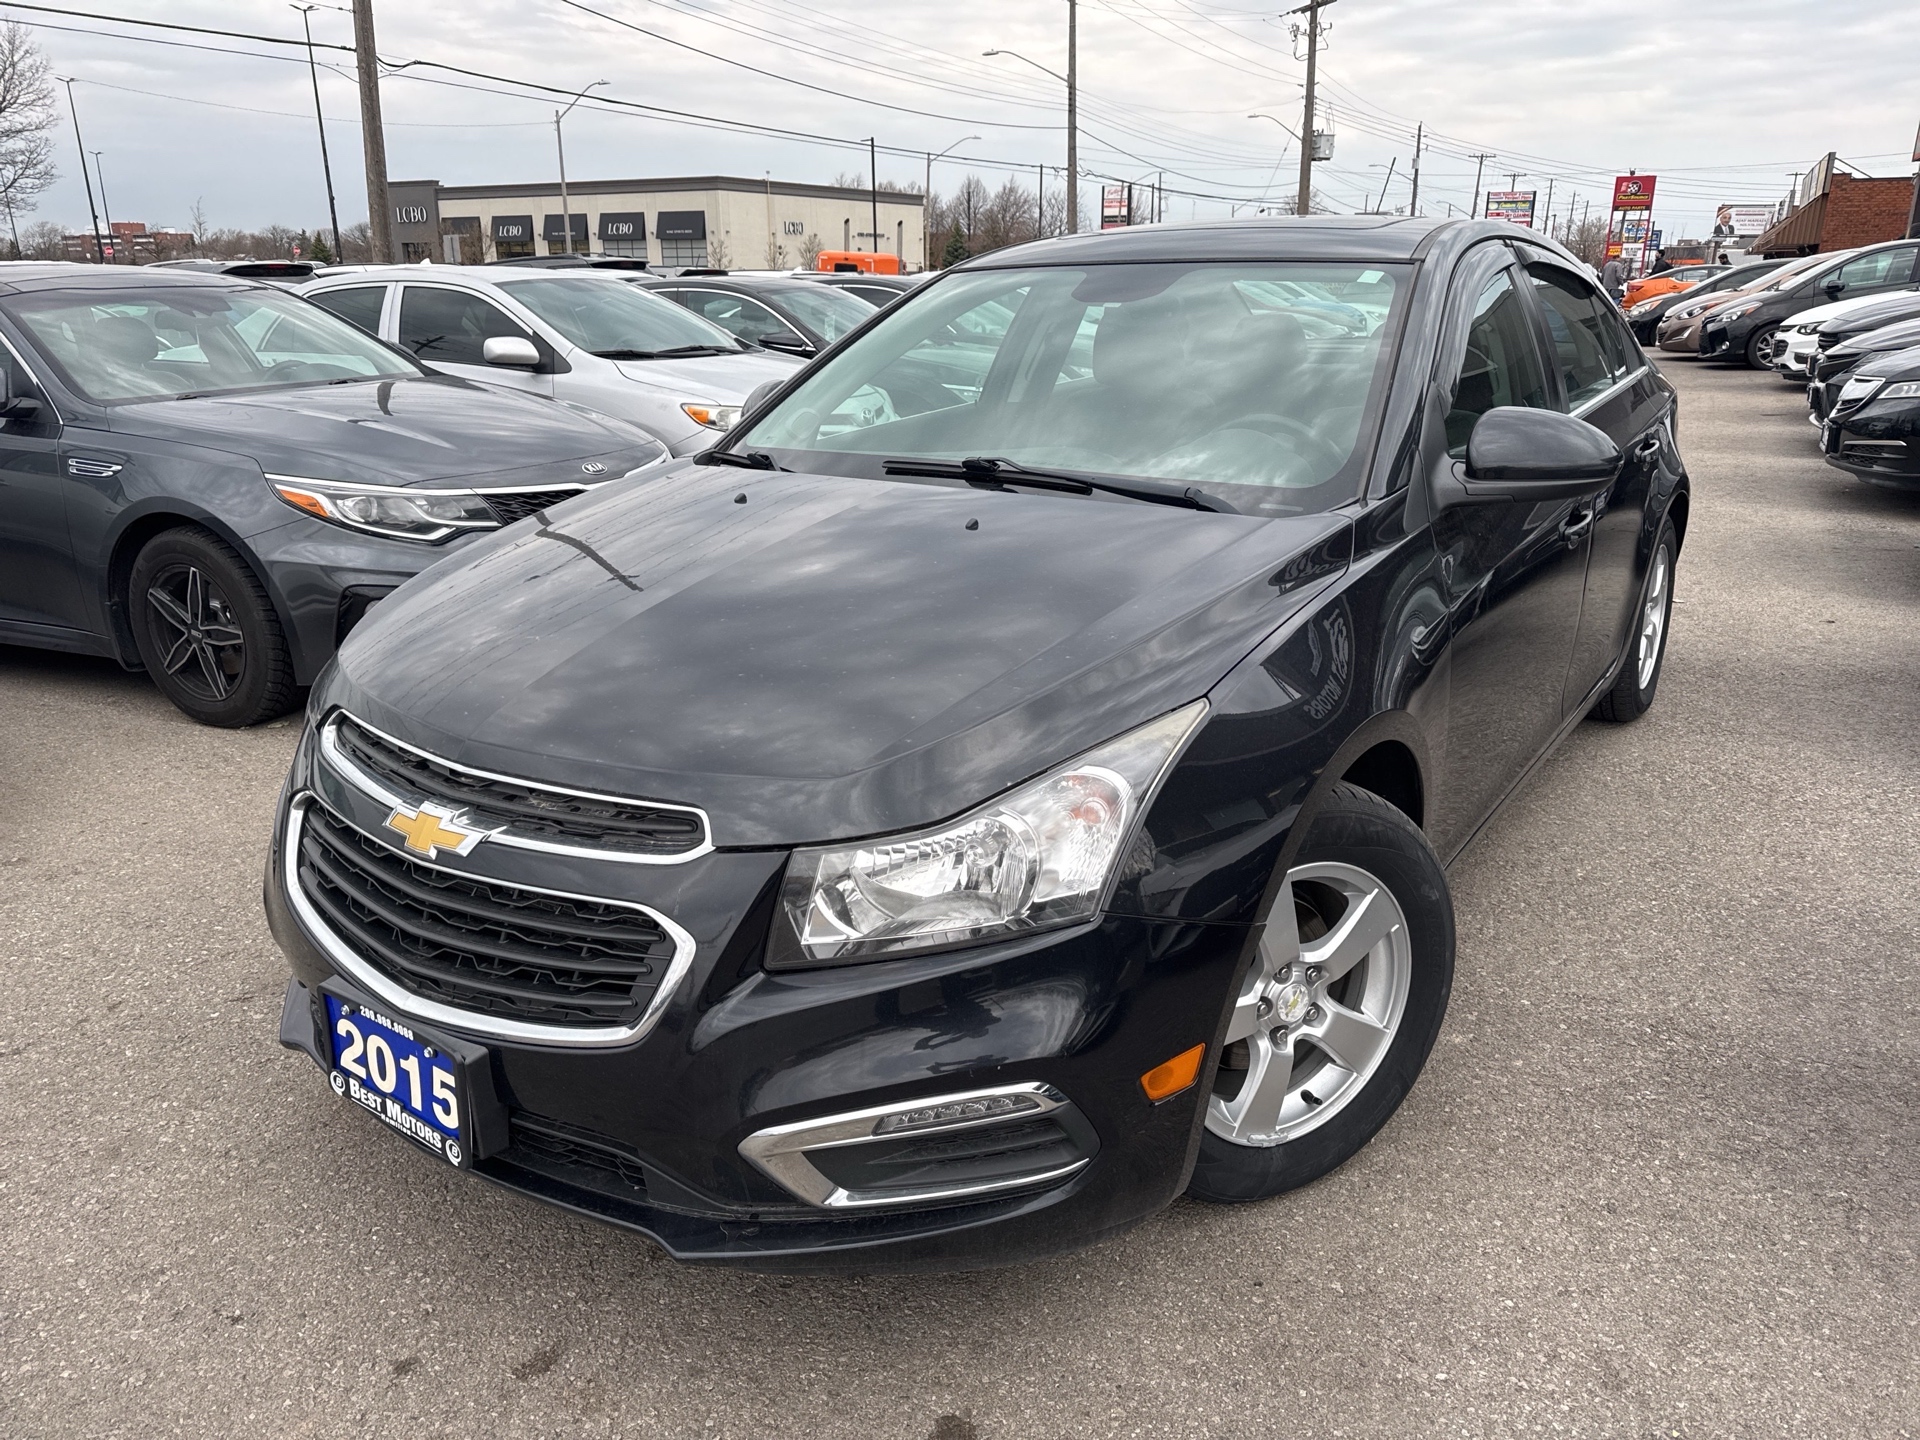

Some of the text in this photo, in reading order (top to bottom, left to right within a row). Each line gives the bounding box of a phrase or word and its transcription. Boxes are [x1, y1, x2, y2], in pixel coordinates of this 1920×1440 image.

[396, 206, 427, 223] LCBO
[499, 225, 522, 236] LCBO
[608, 222, 633, 234] LCBO
[783, 221, 804, 235] LCBO
[585, 463, 605, 472] KIA
[336, 1018, 459, 1129] 2015
[349, 1077, 442, 1149] BEST MOTORS
